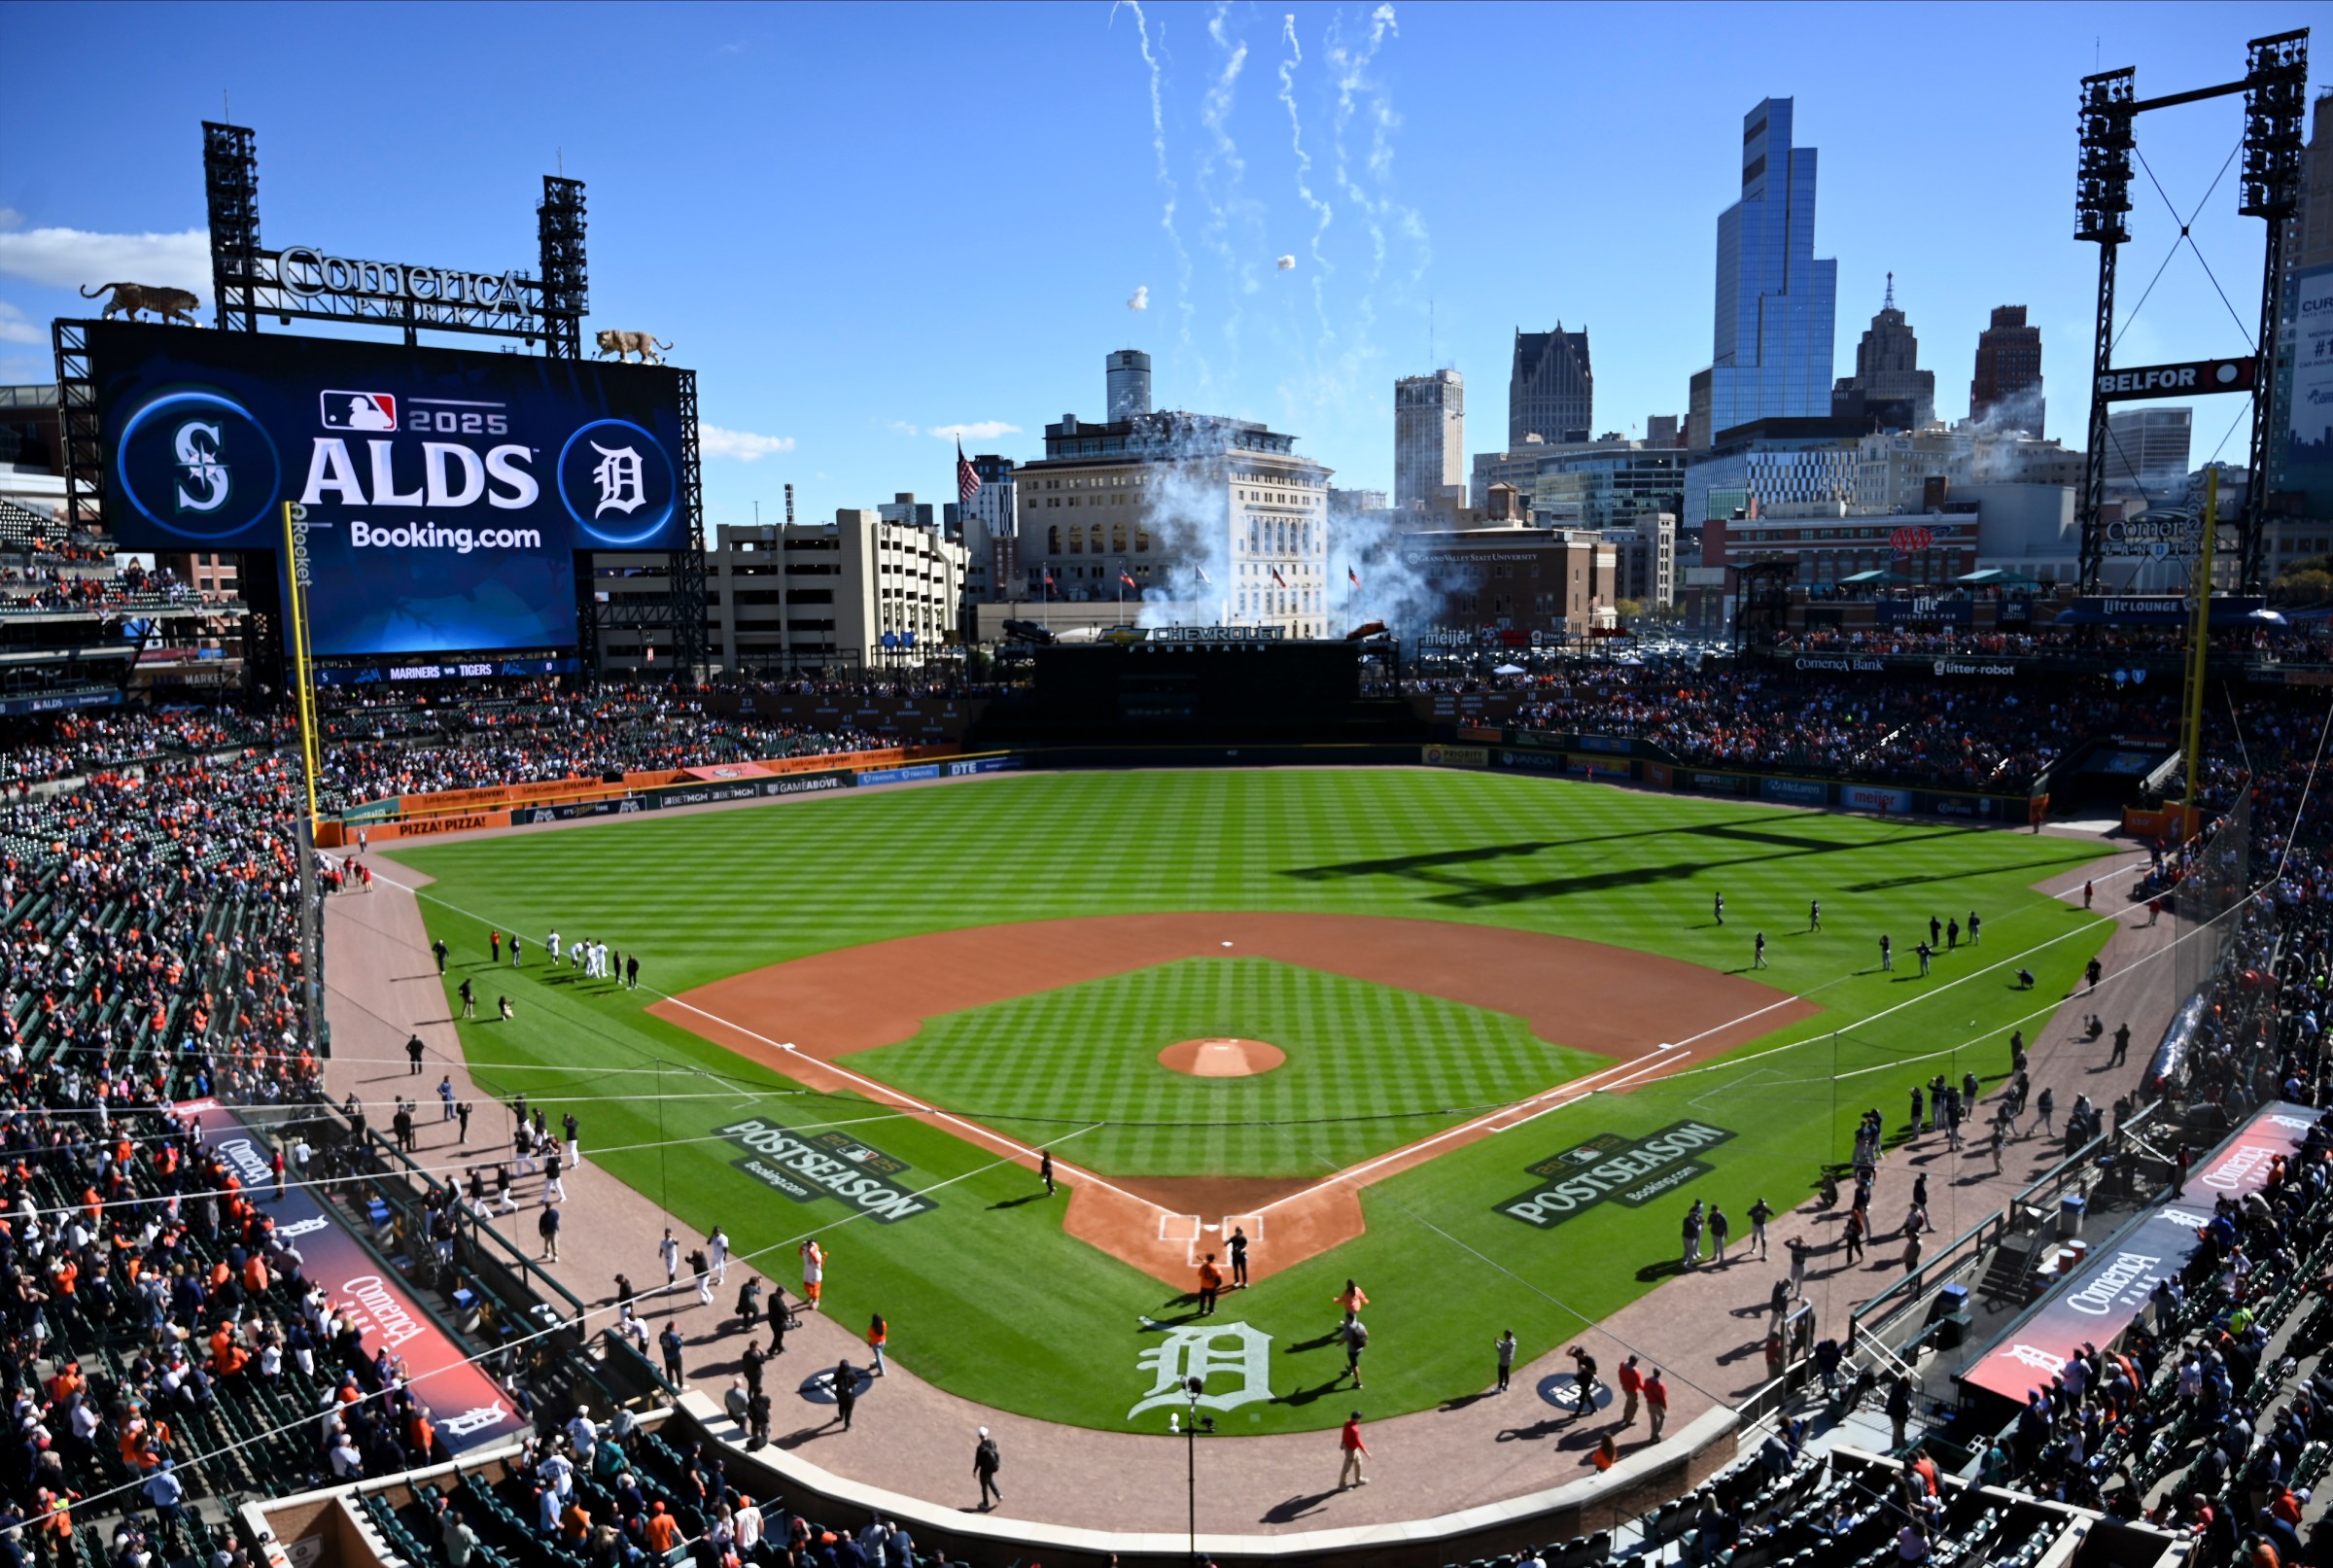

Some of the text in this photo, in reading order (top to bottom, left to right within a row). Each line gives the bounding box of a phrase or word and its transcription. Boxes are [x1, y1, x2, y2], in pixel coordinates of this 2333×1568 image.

[355, 297, 470, 324] PARK
[2100, 367, 2196, 394] BELFOR
[408, 410, 507, 435] 2025
[299, 437, 540, 509] ALDS
[351, 521, 540, 553] Booking.com
[1892, 528, 1931, 550] AAA
[294, 522, 312, 587] Rocket
[1444, 553, 1470, 562] VALLEY
[1492, 552, 1538, 561] UNIVERSITY
[1912, 596, 1938, 614] Lite
[2103, 599, 2177, 615] Lite LOUNGE
[1154, 627, 1284, 642] CHEVROLET
[1425, 629, 1473, 647] meijer
[390, 666, 440, 680] MARINERS
[460, 664, 492, 678] TIGERS
[1853, 659, 1885, 672] Bank
[185, 673, 226, 684] MARKET
[41, 698, 63, 709] ALDS
[1444, 749, 1482, 758] PRIORITY
[1513, 753, 1553, 766] VANDA
[953, 762, 977, 776] DTE
[780, 778, 838, 793] GAMEABOVE
[1781, 781, 1820, 794] McLaren
[400, 816, 486, 837] PIZZA! PIZZA!
[723, 1120, 925, 1220] POSTSEASON
[1505, 1123, 1725, 1225] POSTSEASON
[744, 1161, 808, 1198] Booking.com
[1624, 1166, 1700, 1202] Booking.com
[2120, 1273, 2160, 1307] PARK
